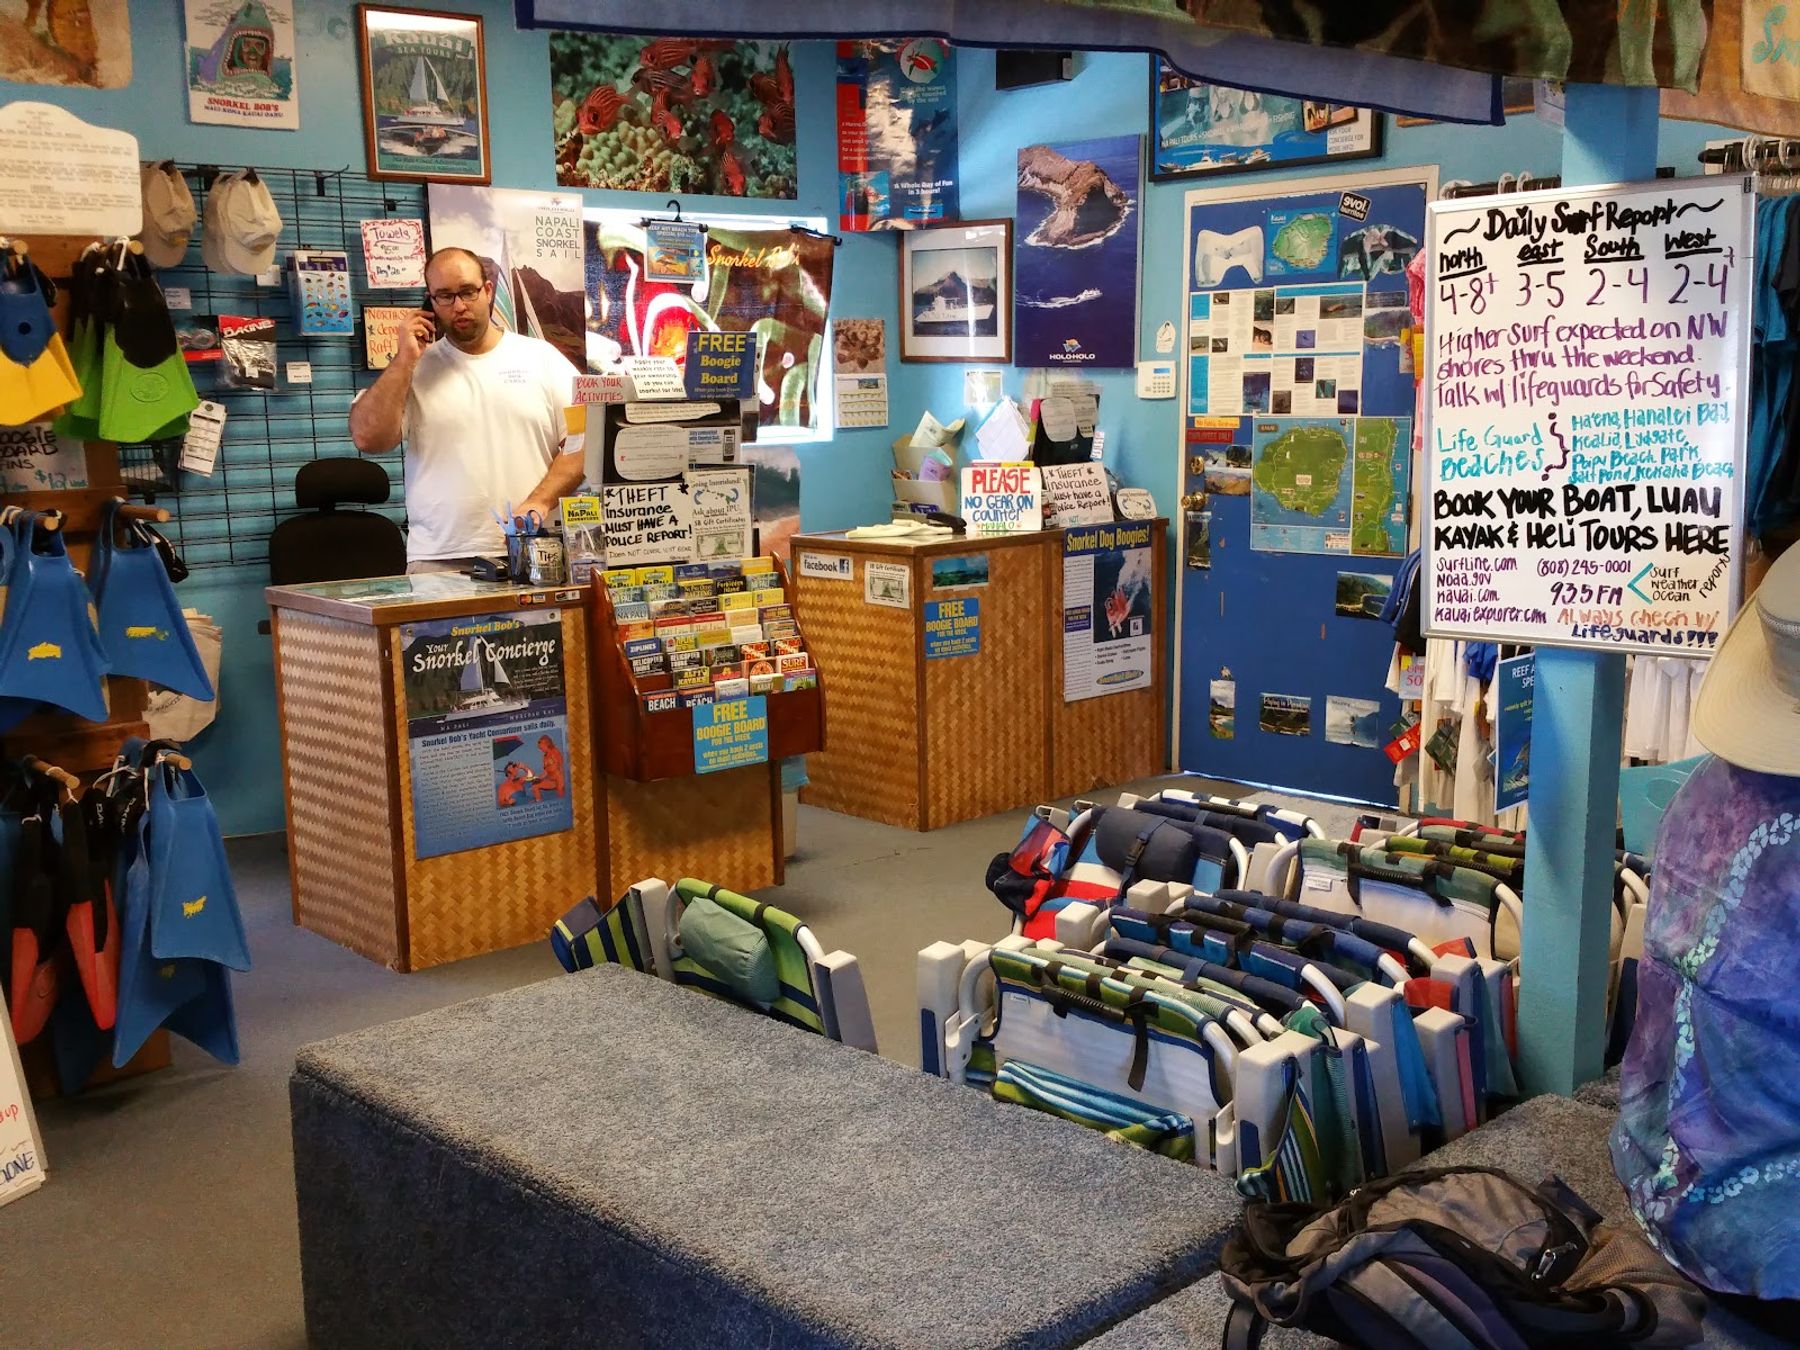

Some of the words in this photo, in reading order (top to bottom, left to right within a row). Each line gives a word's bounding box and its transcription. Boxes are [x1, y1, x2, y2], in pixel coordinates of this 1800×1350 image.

[207, 97, 250, 110] SNORKEL
[254, 103, 279, 112] BOB'S
[535, 216, 580, 229] NAPALI
[1484, 206, 1546, 241] Daily
[1552, 202, 1605, 235] Surf
[1606, 199, 1678, 232] Report
[536, 227, 580, 239] COAST
[536, 238, 580, 249] SNORKEL
[1517, 239, 1564, 258] east
[707, 245, 764, 268] Snorkel
[1516, 269, 1565, 308] 3-5
[1586, 267, 1649, 305] 2-4
[224, 320, 274, 338] DAKINE
[1439, 326, 1508, 360] Higher
[1556, 316, 1646, 351] expected
[1650, 321, 1680, 342] on
[1687, 311, 1728, 341] NW
[698, 334, 747, 352] FREE
[701, 355, 741, 368] Boogie
[1512, 345, 1556, 372] thru
[1562, 345, 1599, 369] the
[576, 376, 598, 388] BOOK
[600, 376, 622, 388] YOUR
[701, 372, 738, 385] Board
[575, 390, 624, 403] ACTIVITIES
[1437, 378, 1480, 407] Talk
[1626, 370, 1653, 398] for
[1624, 406, 1691, 429] Hanalei
[0, 427, 57, 444] OOGIE
[1437, 427, 1478, 452] Life
[1483, 422, 1543, 447] Guard
[0, 444, 59, 457] OARD
[1440, 447, 1545, 482] Beaches
[1610, 450, 1657, 469] Beach
[1055, 466, 1083, 478] THEFT
[972, 468, 1031, 494] PLEASE
[615, 486, 669, 506] THEFT
[965, 495, 982, 509] NO
[986, 494, 1014, 509] GEAR
[1018, 494, 1034, 509] ON
[1073, 491, 1092, 500] have
[1499, 486, 1558, 518] YOUR
[1646, 485, 1721, 518] LUAU
[605, 502, 674, 519] insurance
[1057, 502, 1076, 513] olice
[605, 521, 634, 535] MUST
[637, 515, 665, 531] HAVE
[669, 515, 679, 527] A
[605, 535, 643, 548] POLICE
[1067, 532, 1098, 552] Snorkel
[1100, 530, 1115, 550] Dog
[1116, 524, 1150, 548] Boogies!
[1434, 523, 1505, 550] KAYAK
[1579, 518, 1659, 551] TOURS
[1665, 522, 1731, 554] HERE
[803, 560, 838, 573] facebook
[1536, 558, 1569, 577] (808)
[1571, 559, 1632, 575] 245-0001
[716, 580, 744, 588] Forbidden
[1597, 583, 1624, 606] FM
[938, 601, 965, 618] FREE
[451, 622, 491, 637] Snorkel
[493, 619, 520, 631] Bob's
[926, 619, 953, 632] BOOGIE
[954, 616, 978, 629] BOARD
[412, 638, 482, 673] Snorkel
[485, 636, 556, 666] Concierge
[630, 643, 657, 653] ZIPLINES
[670, 651, 700, 662] HELICOPTER
[632, 655, 663, 667] HELICOPTER
[782, 656, 806, 668] SURF
[1512, 665, 1531, 679] REEF
[1522, 677, 1535, 689] SPE
[648, 697, 676, 711] BEACH
[713, 700, 748, 723] FREE
[697, 723, 732, 740] BOOGIE
[734, 717, 766, 733] BOARD
[422, 737, 448, 748] Snorkel
[449, 734, 467, 744] Bob's
[468, 730, 487, 740] Yacht
[5, 1103, 20, 1121] up
